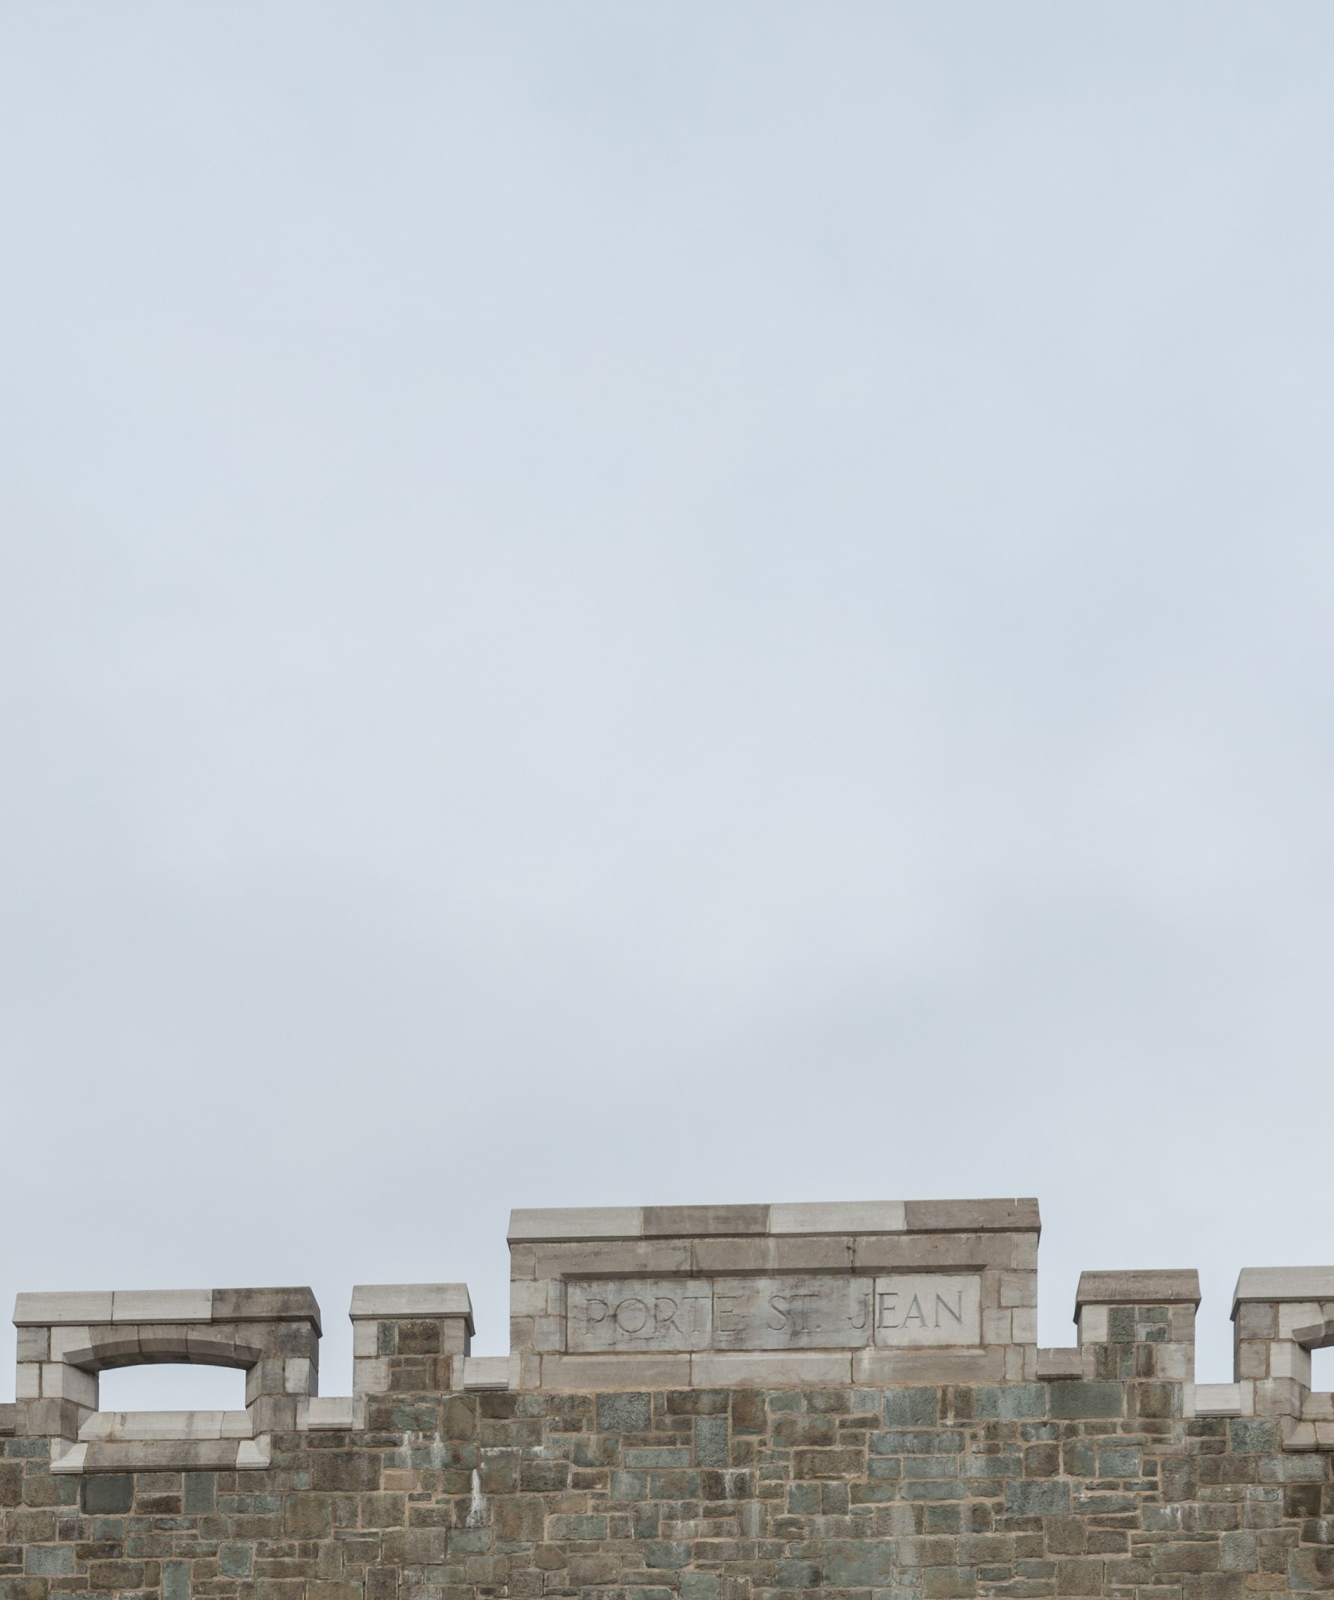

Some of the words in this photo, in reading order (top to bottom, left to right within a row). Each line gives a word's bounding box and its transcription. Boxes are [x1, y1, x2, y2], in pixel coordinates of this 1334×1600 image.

[585, 1296, 738, 1336] PORTE
[767, 1293, 822, 1331] ST.
[846, 1290, 963, 1331] JEAN
